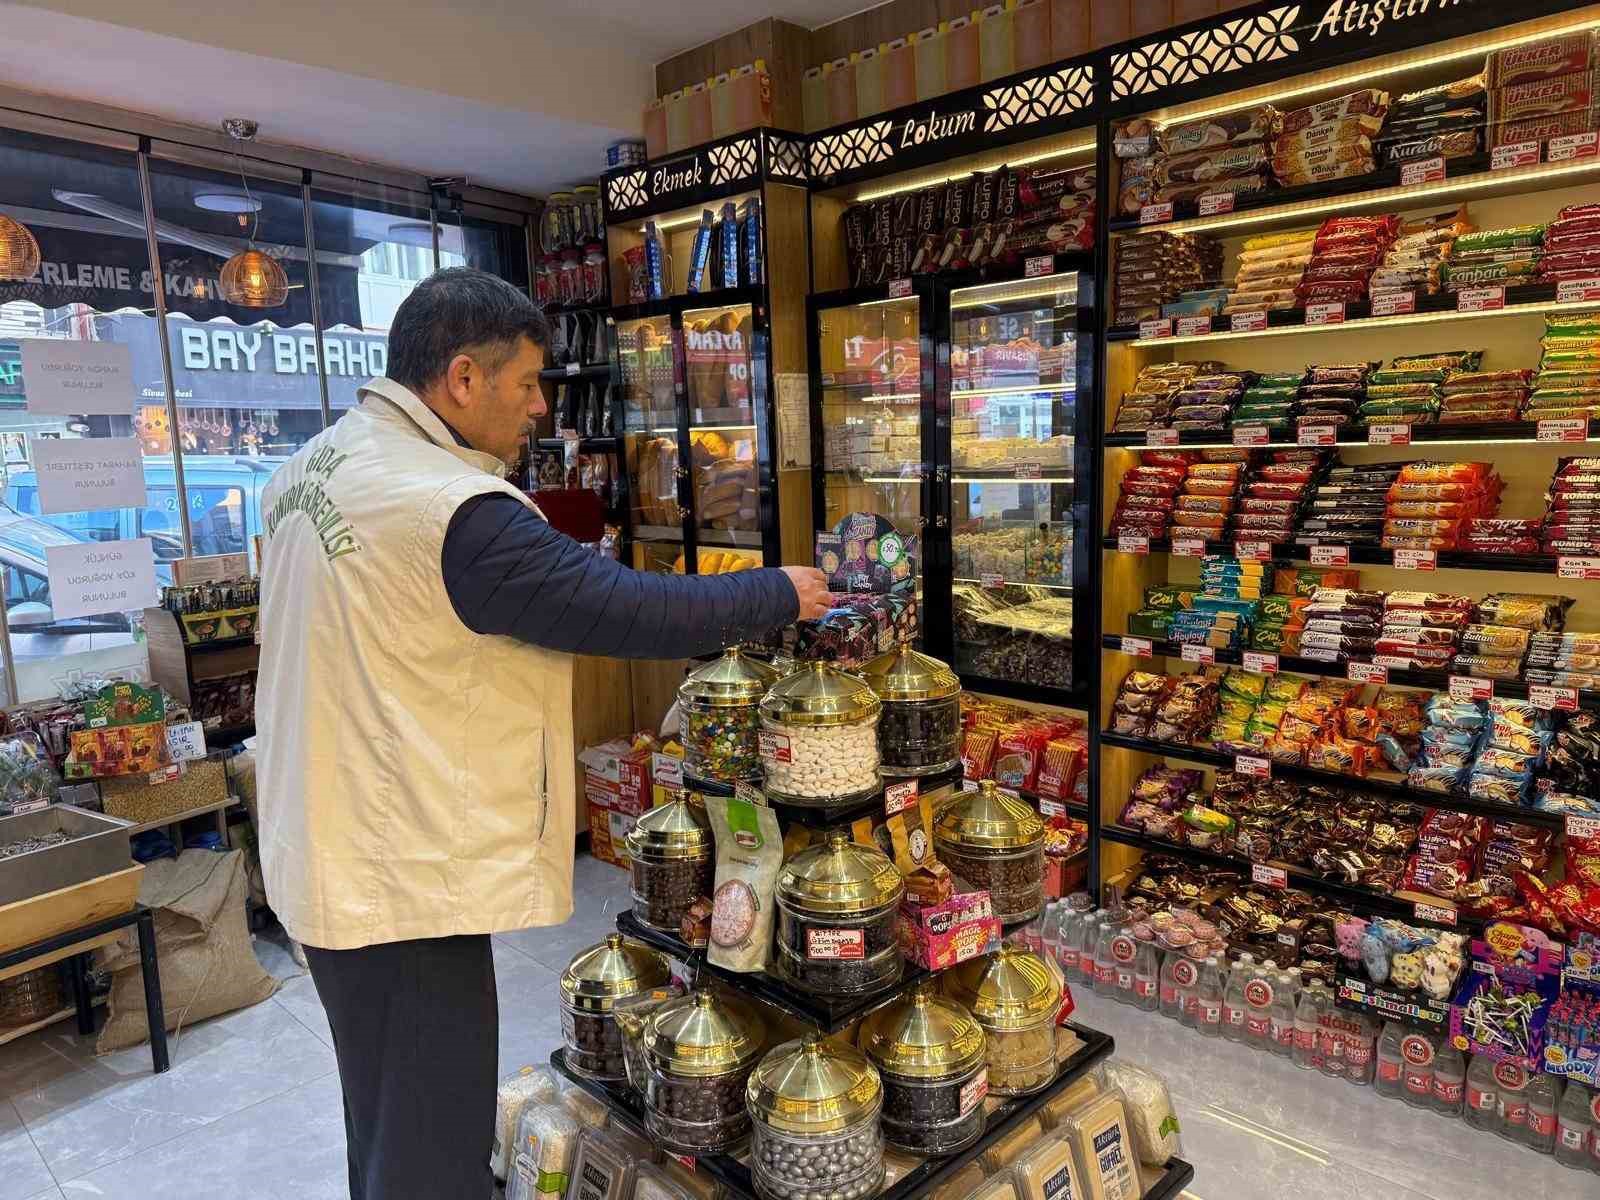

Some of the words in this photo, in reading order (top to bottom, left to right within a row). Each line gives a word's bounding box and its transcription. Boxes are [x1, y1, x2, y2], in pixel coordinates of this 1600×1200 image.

[900, 111, 976, 149] Lokum
[653, 156, 702, 196] Ekmek
[164, 273, 224, 301] KAHV
[181, 327, 262, 372] BAY
[305, 444, 348, 479] GIDA
[956, 927, 982, 940] MAGIC
[957, 934, 981, 948] POPS
[1546, 1061, 1595, 1076] MELODY
